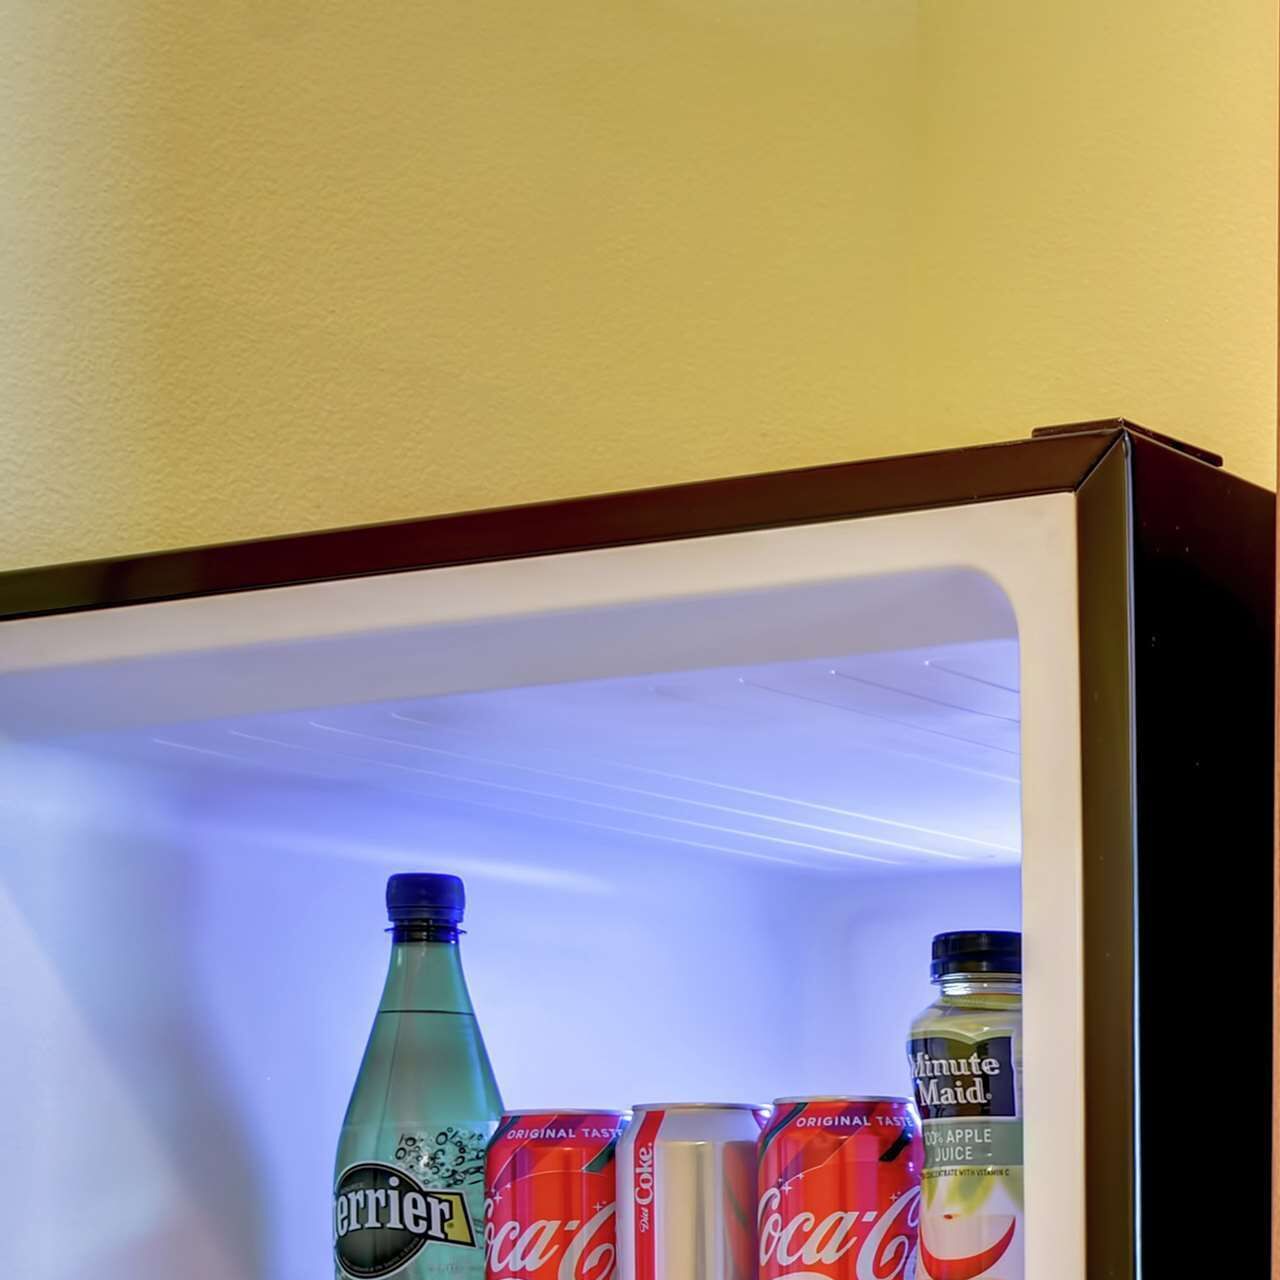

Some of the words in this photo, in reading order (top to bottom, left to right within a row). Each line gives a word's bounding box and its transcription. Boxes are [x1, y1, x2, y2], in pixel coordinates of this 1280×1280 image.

[914, 1052, 1000, 1077] Minute
[919, 1078, 986, 1106] Maid
[796, 1116, 871, 1128] ORIGINAL
[507, 1128, 576, 1140] ORIGINAL
[925, 1131, 944, 1146] 00%
[946, 1129, 992, 1143] APPLE
[935, 1146, 973, 1162] JUICE
[335, 1175, 451, 1239] errier
[639, 1207, 650, 1233] Diet
